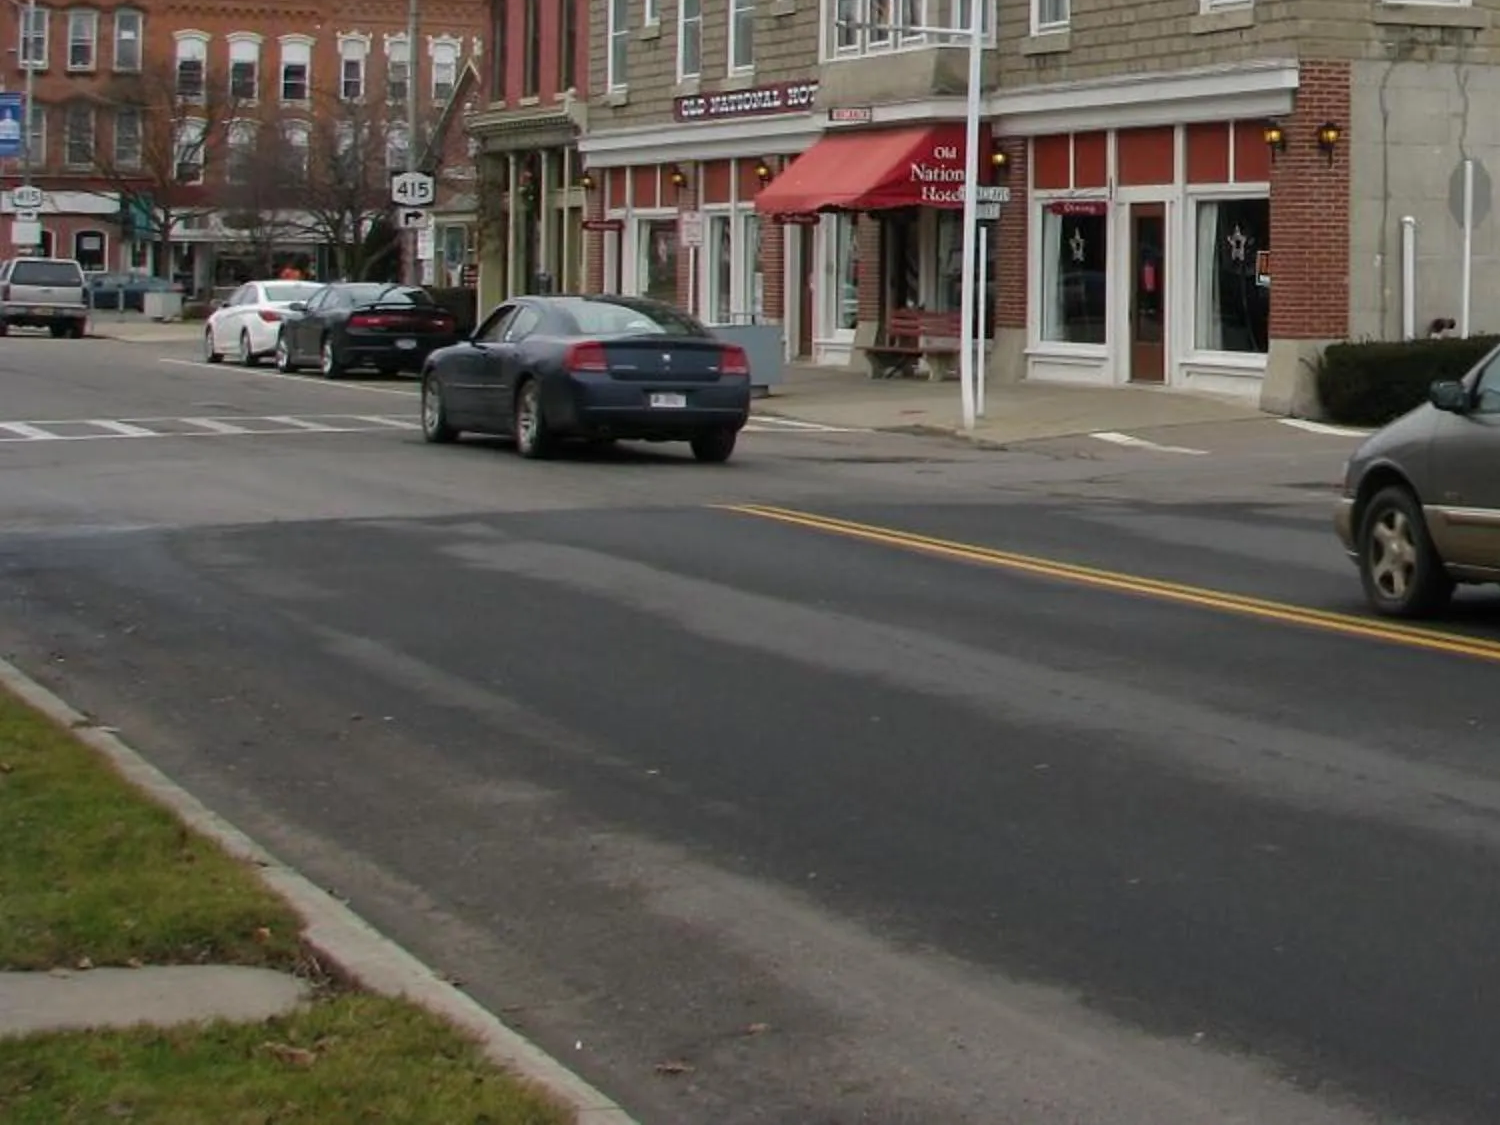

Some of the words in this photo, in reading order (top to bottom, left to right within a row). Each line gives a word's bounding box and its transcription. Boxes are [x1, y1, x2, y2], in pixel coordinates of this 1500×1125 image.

[681, 97, 707, 116] OLD
[709, 89, 781, 113] NATIONAL
[787, 85, 819, 106] HOT
[934, 146, 957, 159] Old
[911, 162, 966, 182] Nation
[17, 190, 39, 202] 415
[397, 181, 429, 198] 415
[921, 186, 963, 202] Hote
